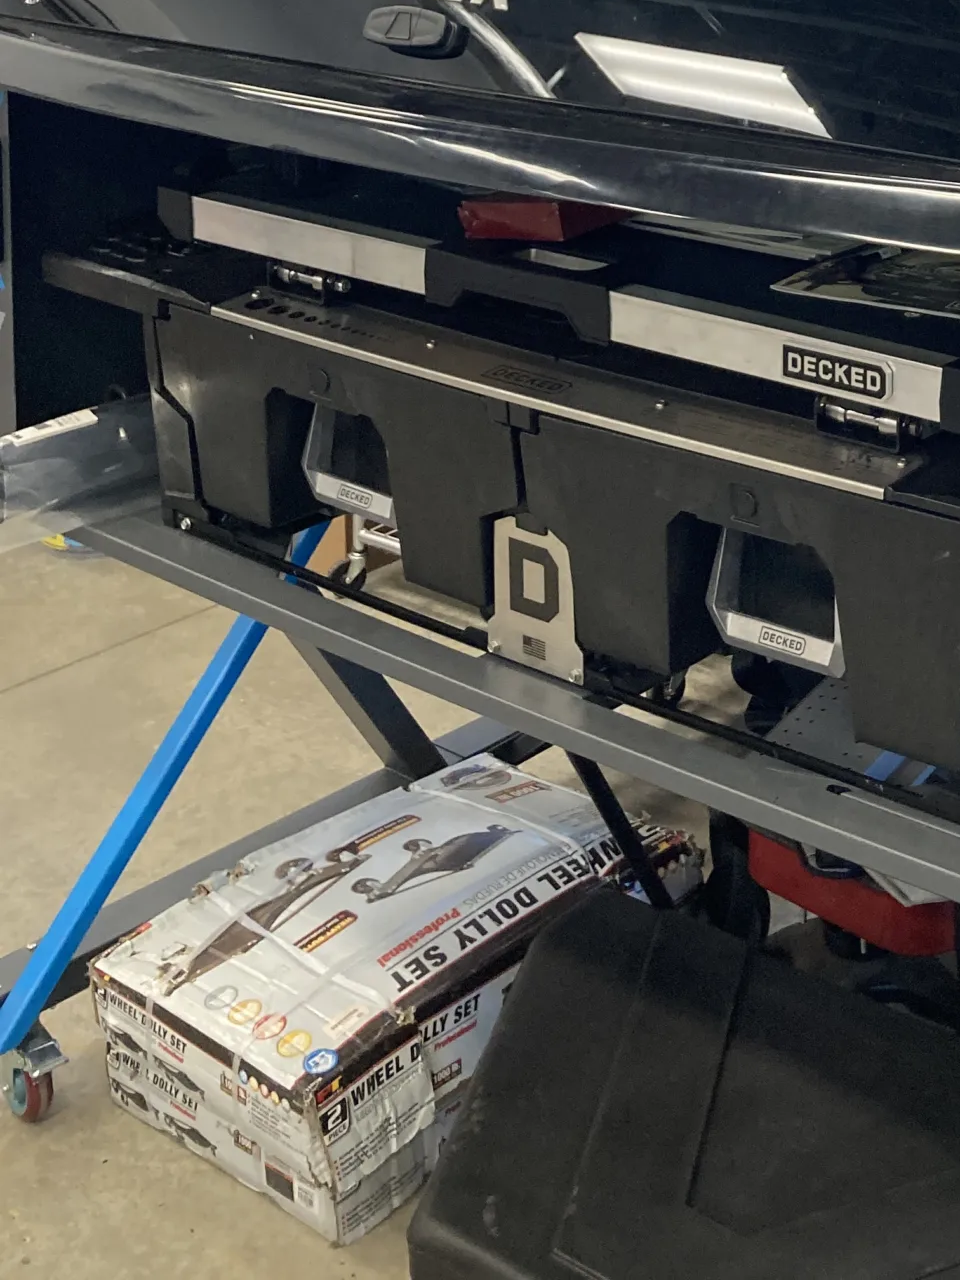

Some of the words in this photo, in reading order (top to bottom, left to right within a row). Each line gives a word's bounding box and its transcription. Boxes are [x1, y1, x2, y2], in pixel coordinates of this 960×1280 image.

[492, 368, 564, 391] DECKED
[787, 351, 881, 392] DECKED
[340, 488, 370, 505] DECKED
[508, 536, 559, 623] D
[762, 631, 803, 651] DECKED
[376, 907, 462, 969] Professional
[453, 886, 539, 951] DOLLY
[390, 945, 448, 993] SET
[109, 991, 139, 1021] WHEEL
[170, 1034, 188, 1054] SET
[351, 1055, 405, 1106] WHEEL
[410, 1012, 449, 1062] DLLY
[453, 993, 481, 1025] SET
[122, 1053, 150, 1080] WHEL
[152, 1073, 180, 1098] DOLLY
[182, 1093, 198, 1112] SET
[327, 1103, 342, 1131] 2
[328, 1122, 347, 1142] PIECE
